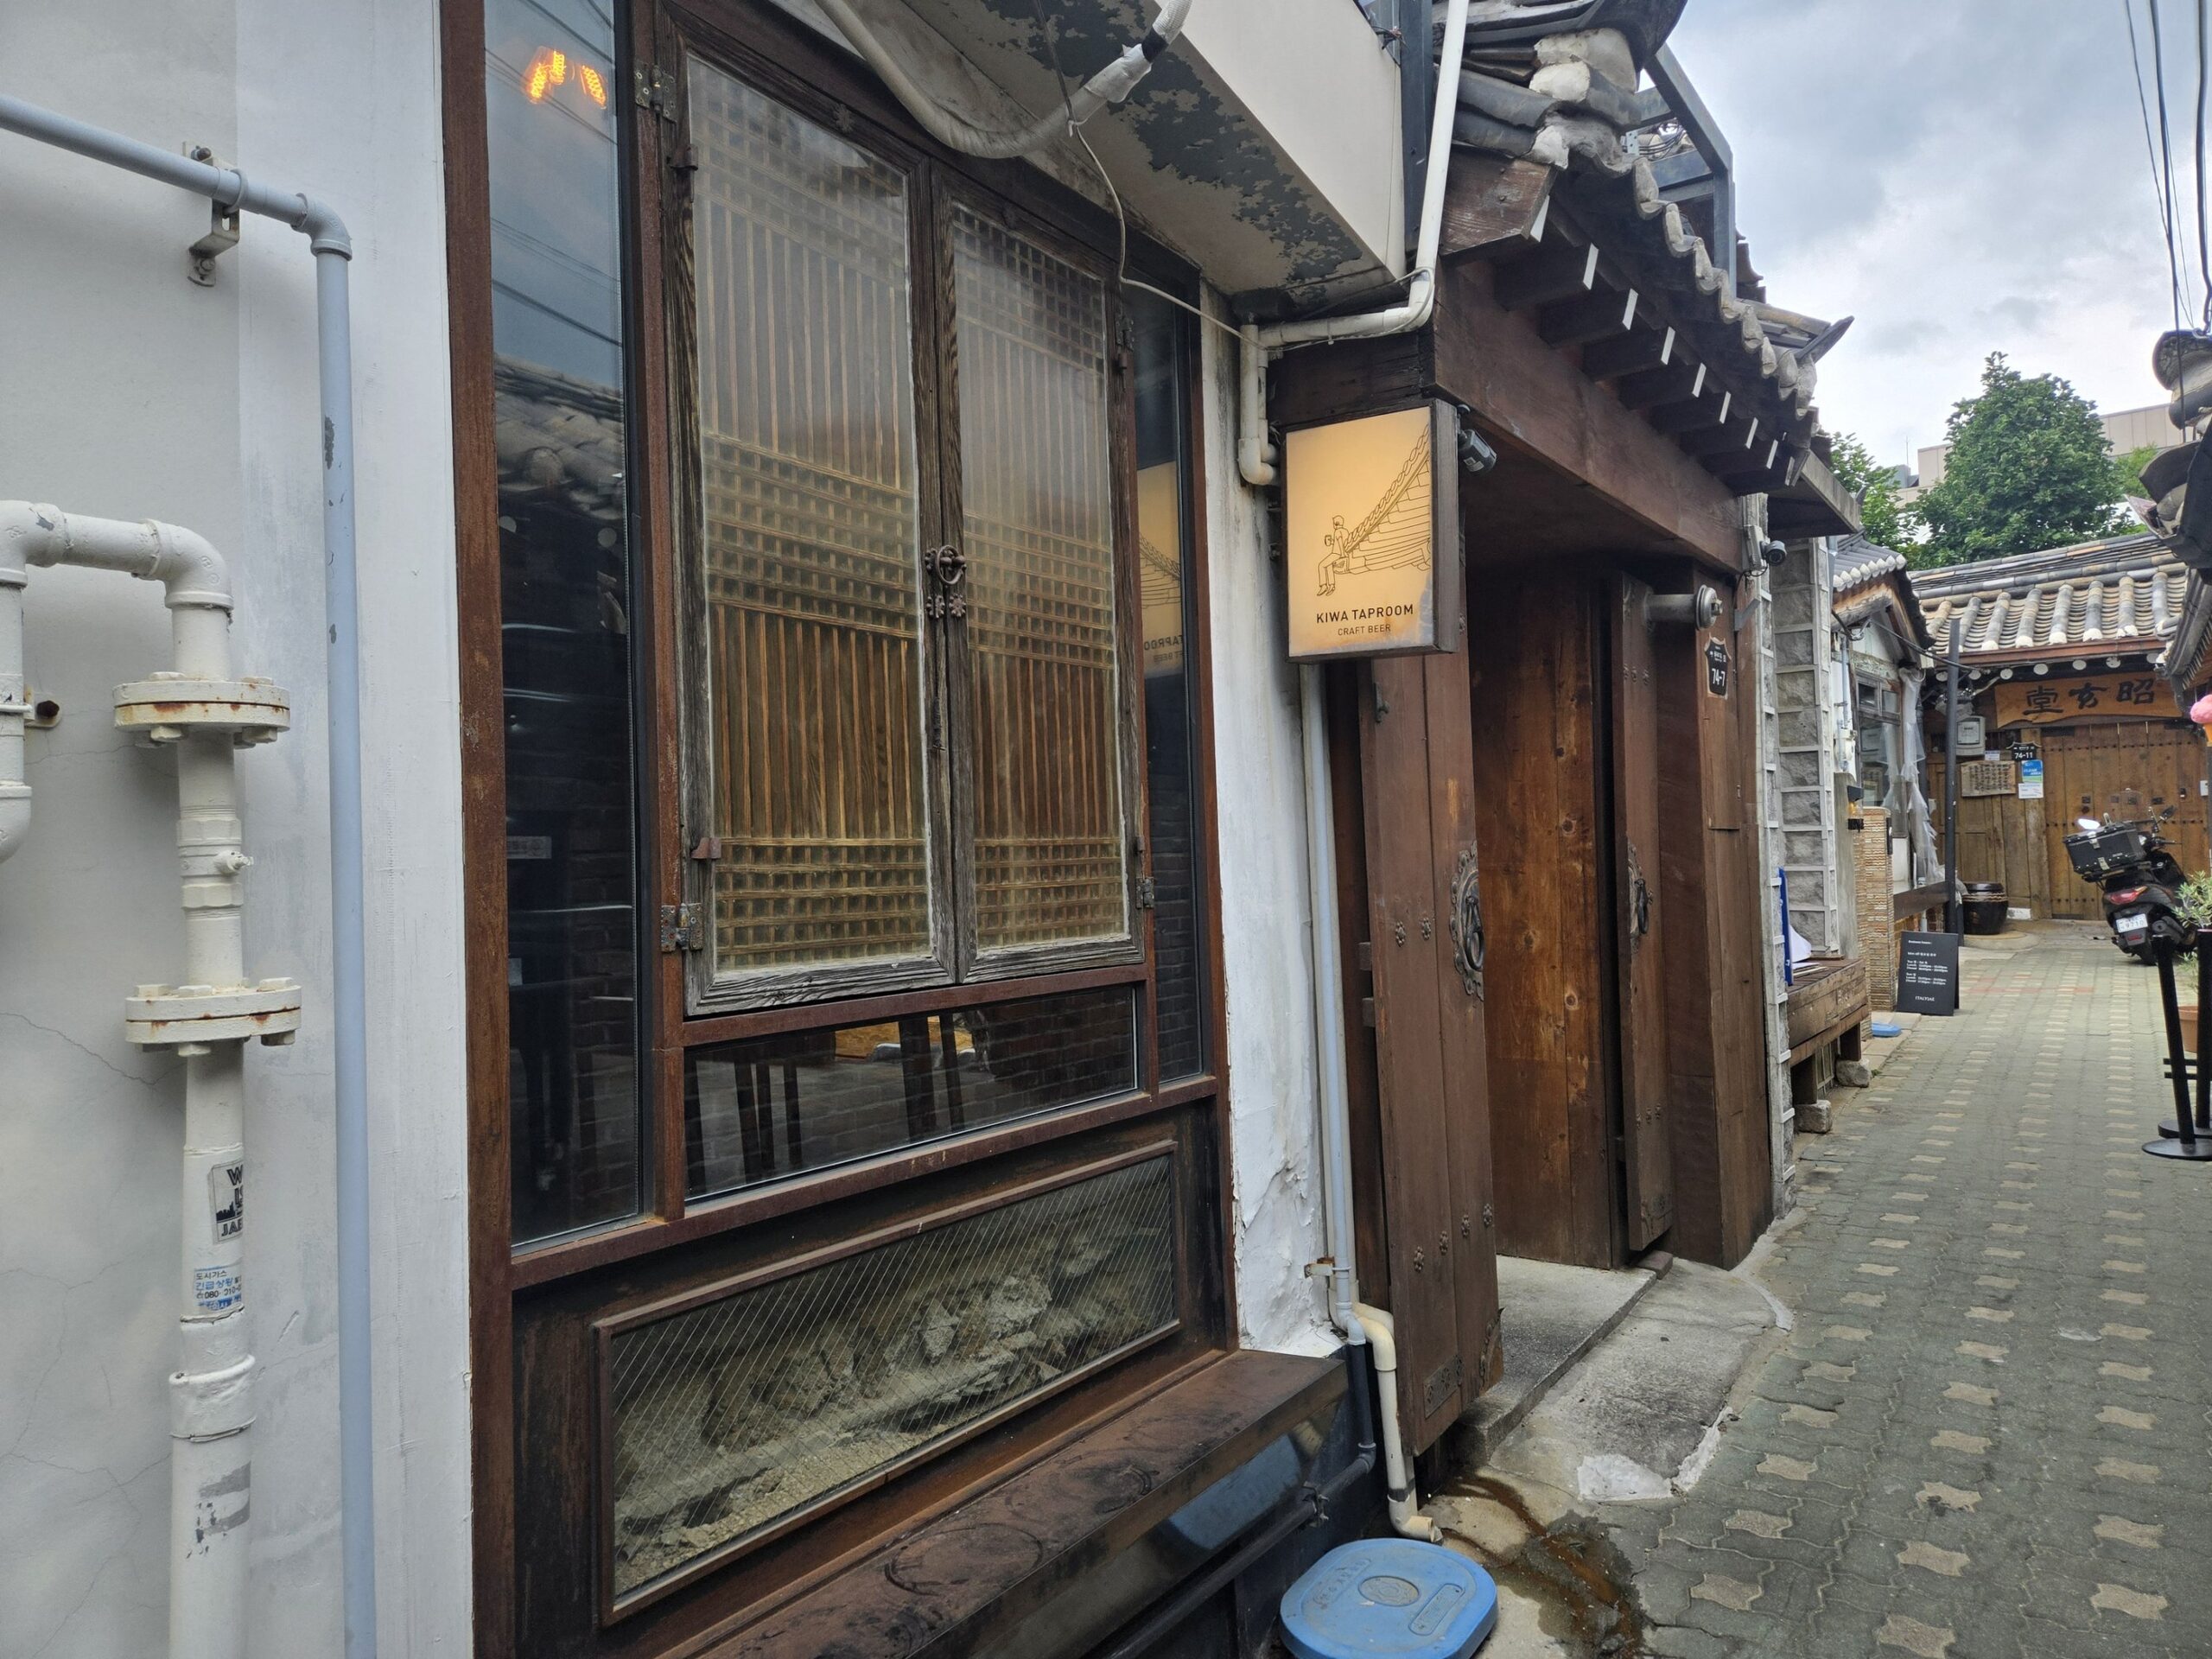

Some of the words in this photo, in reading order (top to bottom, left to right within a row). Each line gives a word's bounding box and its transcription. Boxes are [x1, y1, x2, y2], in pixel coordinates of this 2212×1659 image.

[1316, 610, 1349, 624] KIWA
[1351, 604, 1414, 620] TAPROOM
[1338, 626, 1365, 636] CRAFT
[1368, 624, 1391, 633] BEER
[1712, 668, 1726, 687] 74-7
[196, 1270, 227, 1280] 도시가스
